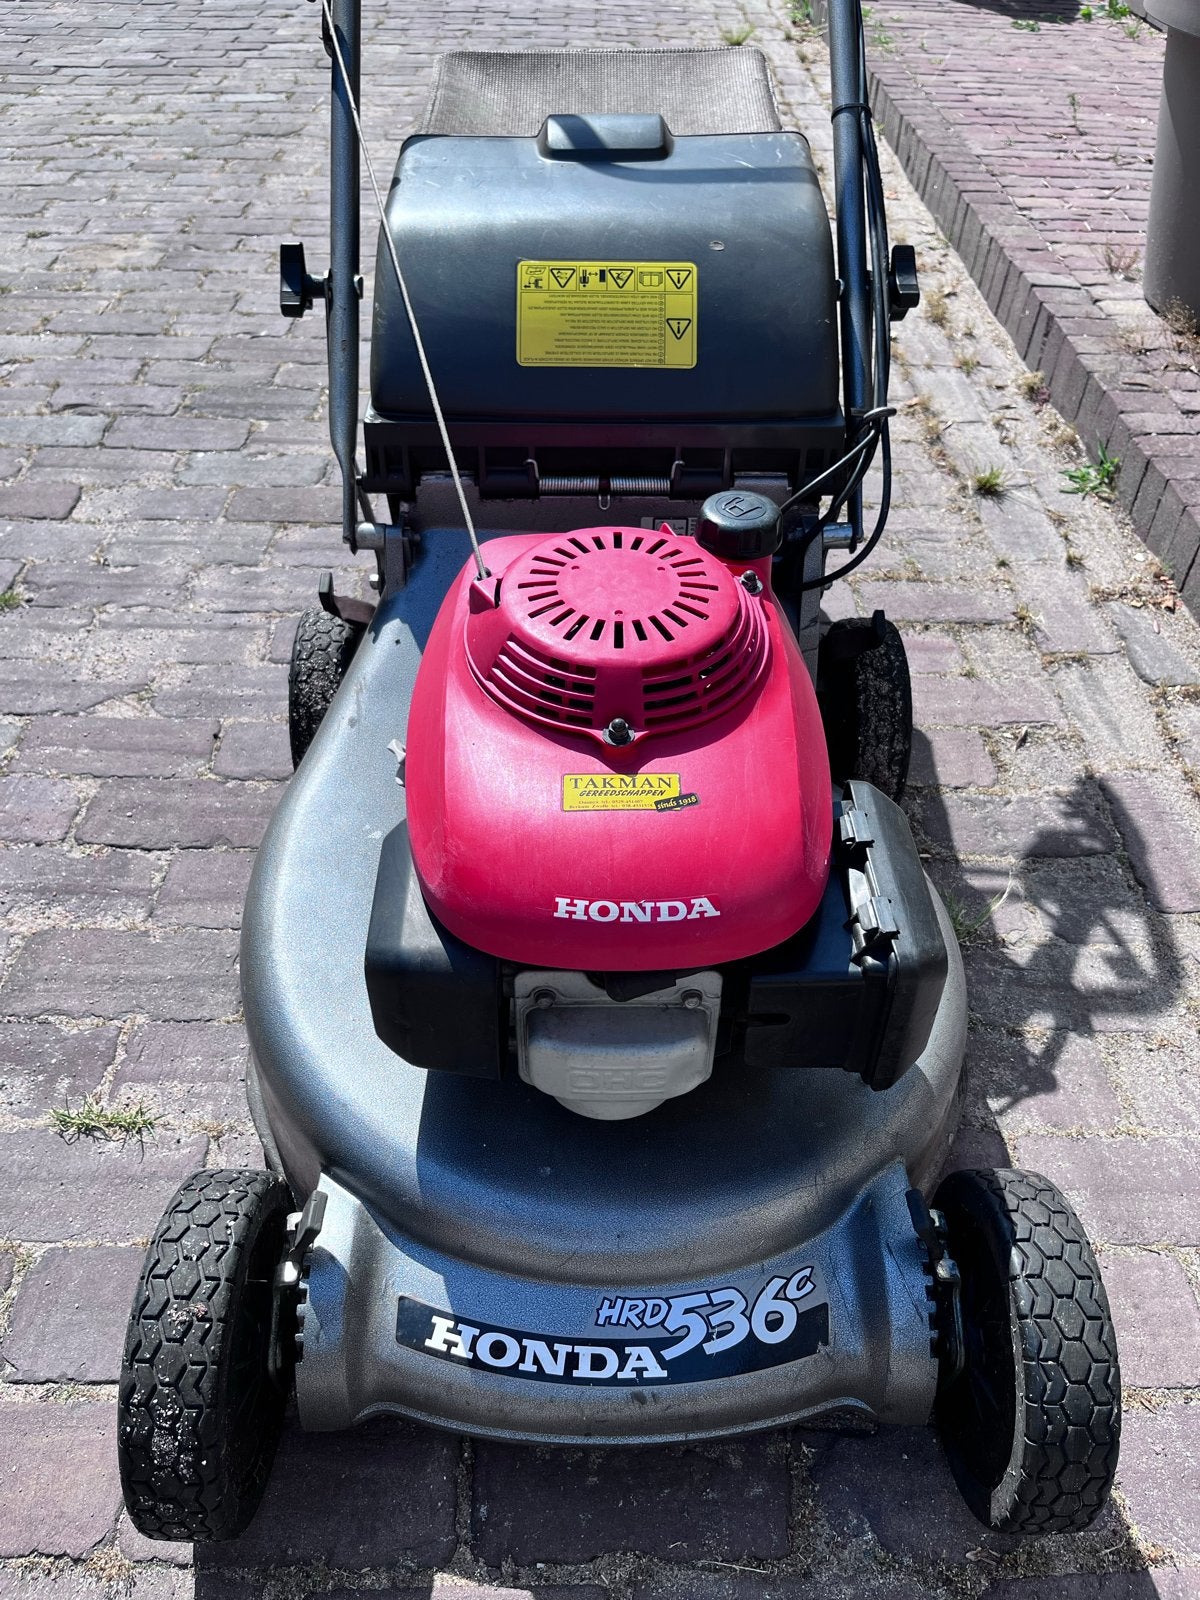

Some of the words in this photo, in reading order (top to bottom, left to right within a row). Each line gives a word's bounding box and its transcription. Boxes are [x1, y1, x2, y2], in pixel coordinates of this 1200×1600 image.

[569, 777, 672, 789] TAKMAN
[578, 789, 667, 797] GEREEDSCHAPPEN
[657, 798, 678, 810] sinds
[678, 795, 697, 806] 1918
[553, 896, 721, 923] HONDA
[424, 1314, 668, 1380] HONDA
